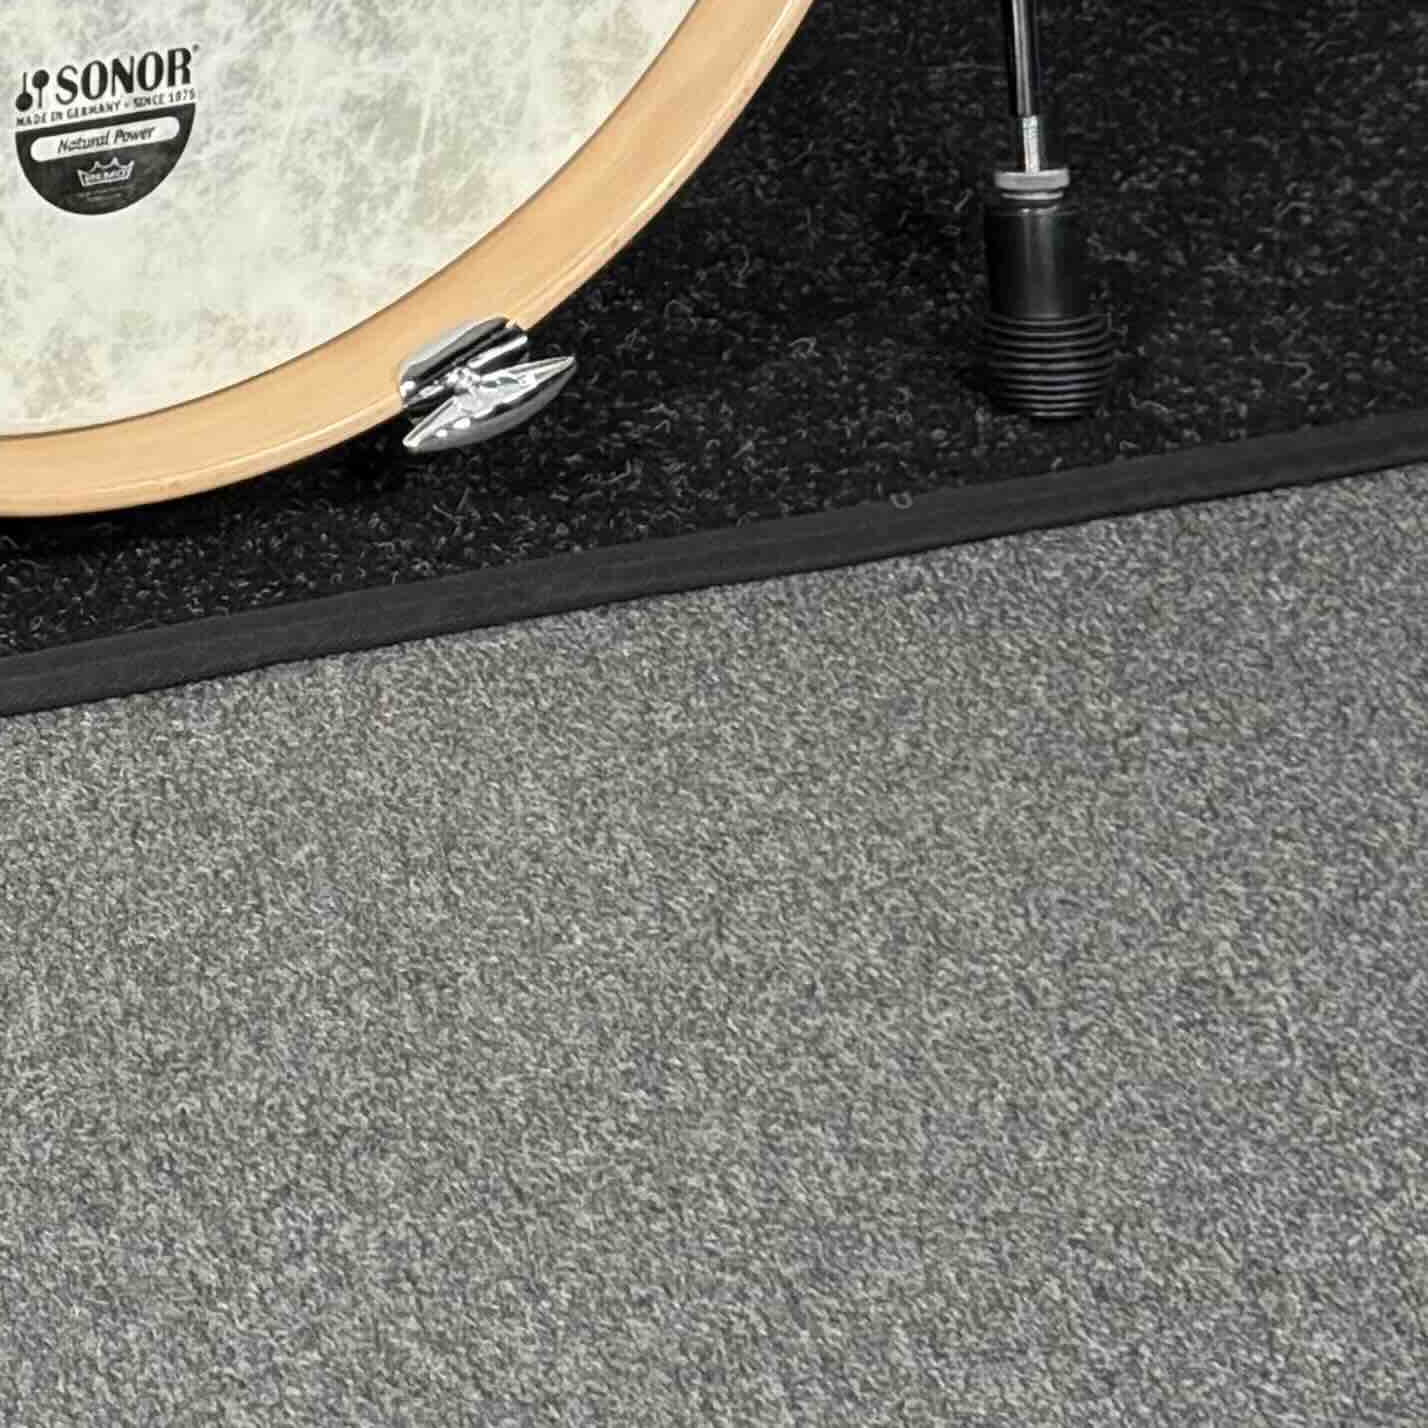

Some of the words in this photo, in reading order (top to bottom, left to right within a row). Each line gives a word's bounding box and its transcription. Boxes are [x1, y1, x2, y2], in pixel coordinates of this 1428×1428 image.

[56, 47, 193, 105] SONOR
[16, 112, 47, 127] MADE
[50, 110, 64, 123] IN
[66, 101, 121, 121] GERMANY
[133, 94, 165, 109] SINCE
[56, 131, 110, 155] Natural
[112, 124, 157, 146] Power
